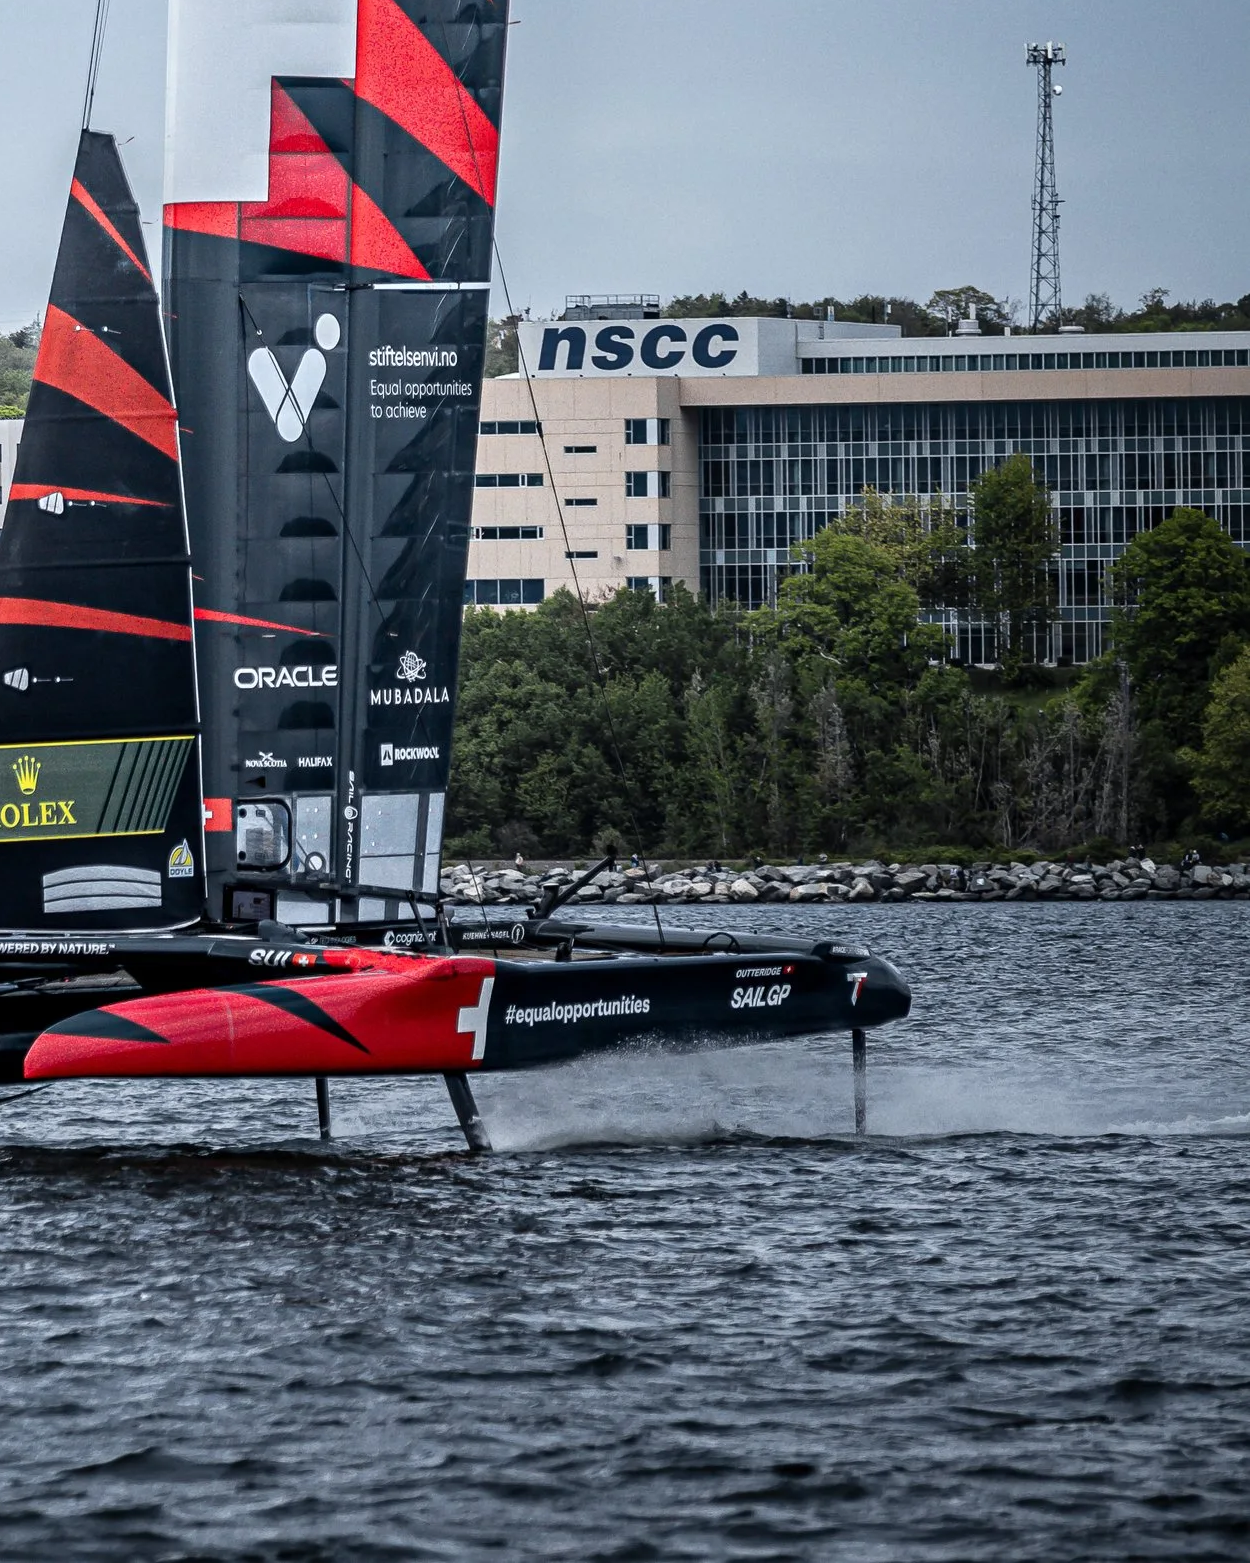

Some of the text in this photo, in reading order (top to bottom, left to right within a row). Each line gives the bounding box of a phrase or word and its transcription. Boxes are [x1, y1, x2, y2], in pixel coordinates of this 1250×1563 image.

[369, 345, 458, 367] stiftelsenvi.no
[538, 323, 739, 371] nscc
[370, 378, 472, 399] Equal opportunities
[370, 402, 427, 419] to achieve
[234, 665, 339, 689] ORACLE
[370, 686, 450, 706] MUBADALA
[298, 757, 333, 767] HALIFAX
[394, 747, 440, 760] ROCKWOOL
[263, 759, 287, 768] SCOTIA
[395, 931, 438, 946] cogniznt
[40, 942, 57, 954] BY
[248, 948, 292, 967] SUI
[735, 966, 782, 978] OUTTERIDGE
[505, 995, 651, 1027] #equalopportunities
